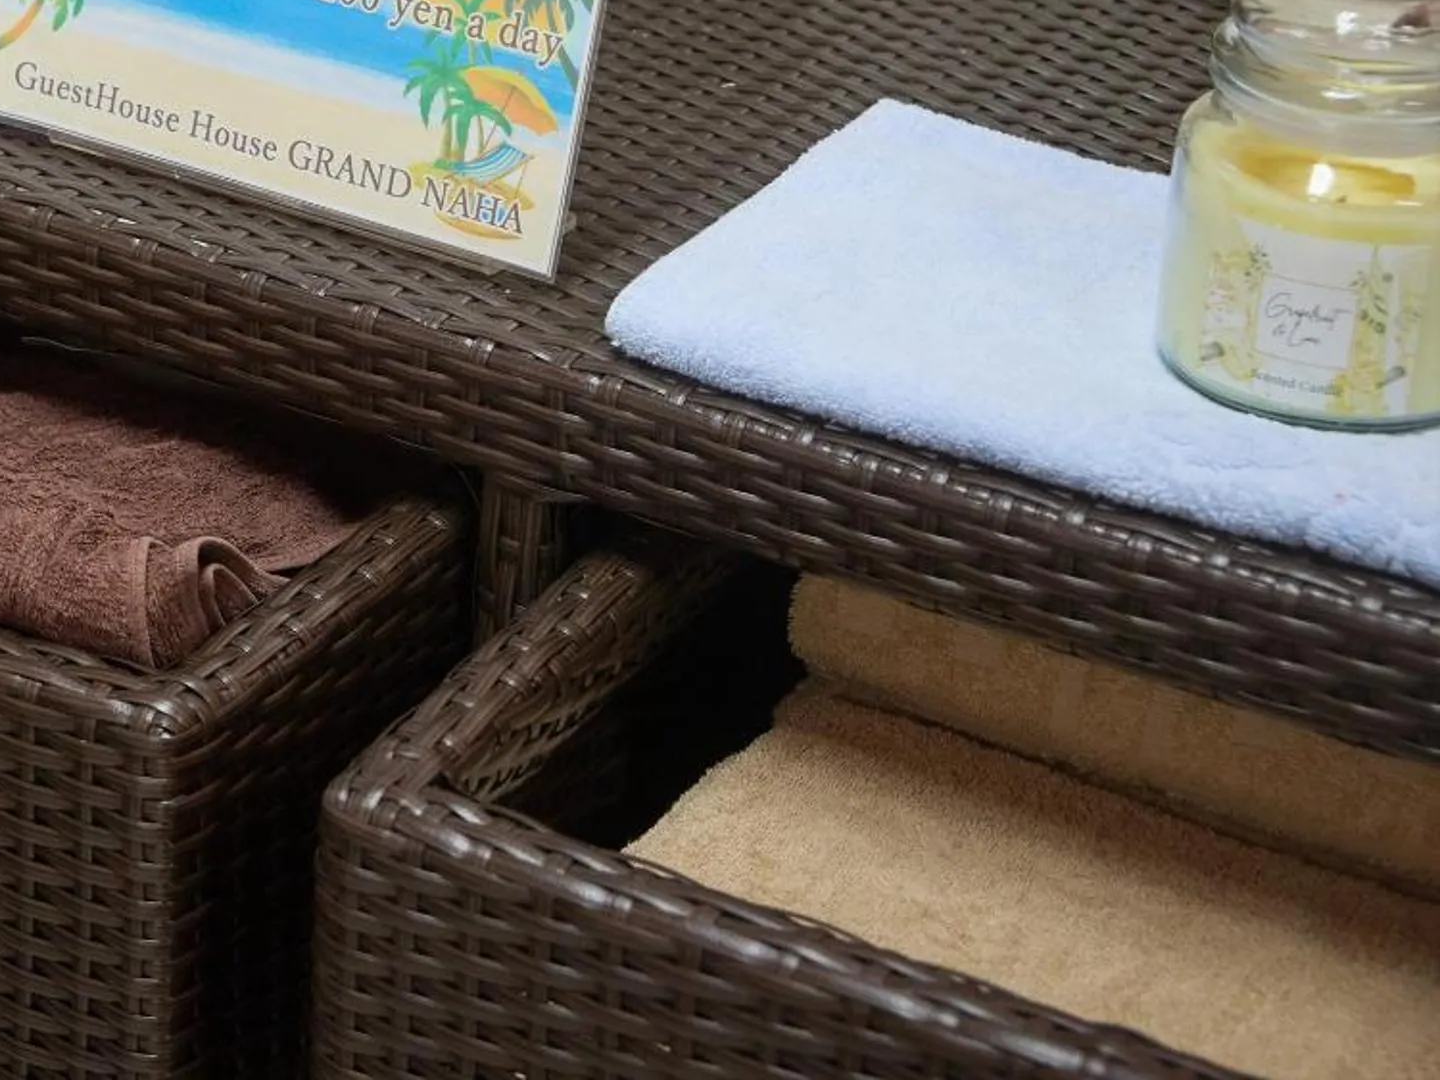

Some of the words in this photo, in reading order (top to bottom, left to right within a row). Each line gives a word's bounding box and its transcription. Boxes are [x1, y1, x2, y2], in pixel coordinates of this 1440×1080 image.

[466, 10, 486, 41] a
[498, 11, 564, 69] day
[14, 60, 180, 134] GuestHouse
[190, 110, 278, 162] House
[287, 139, 414, 200] GRAND
[420, 173, 524, 235] NAHA
